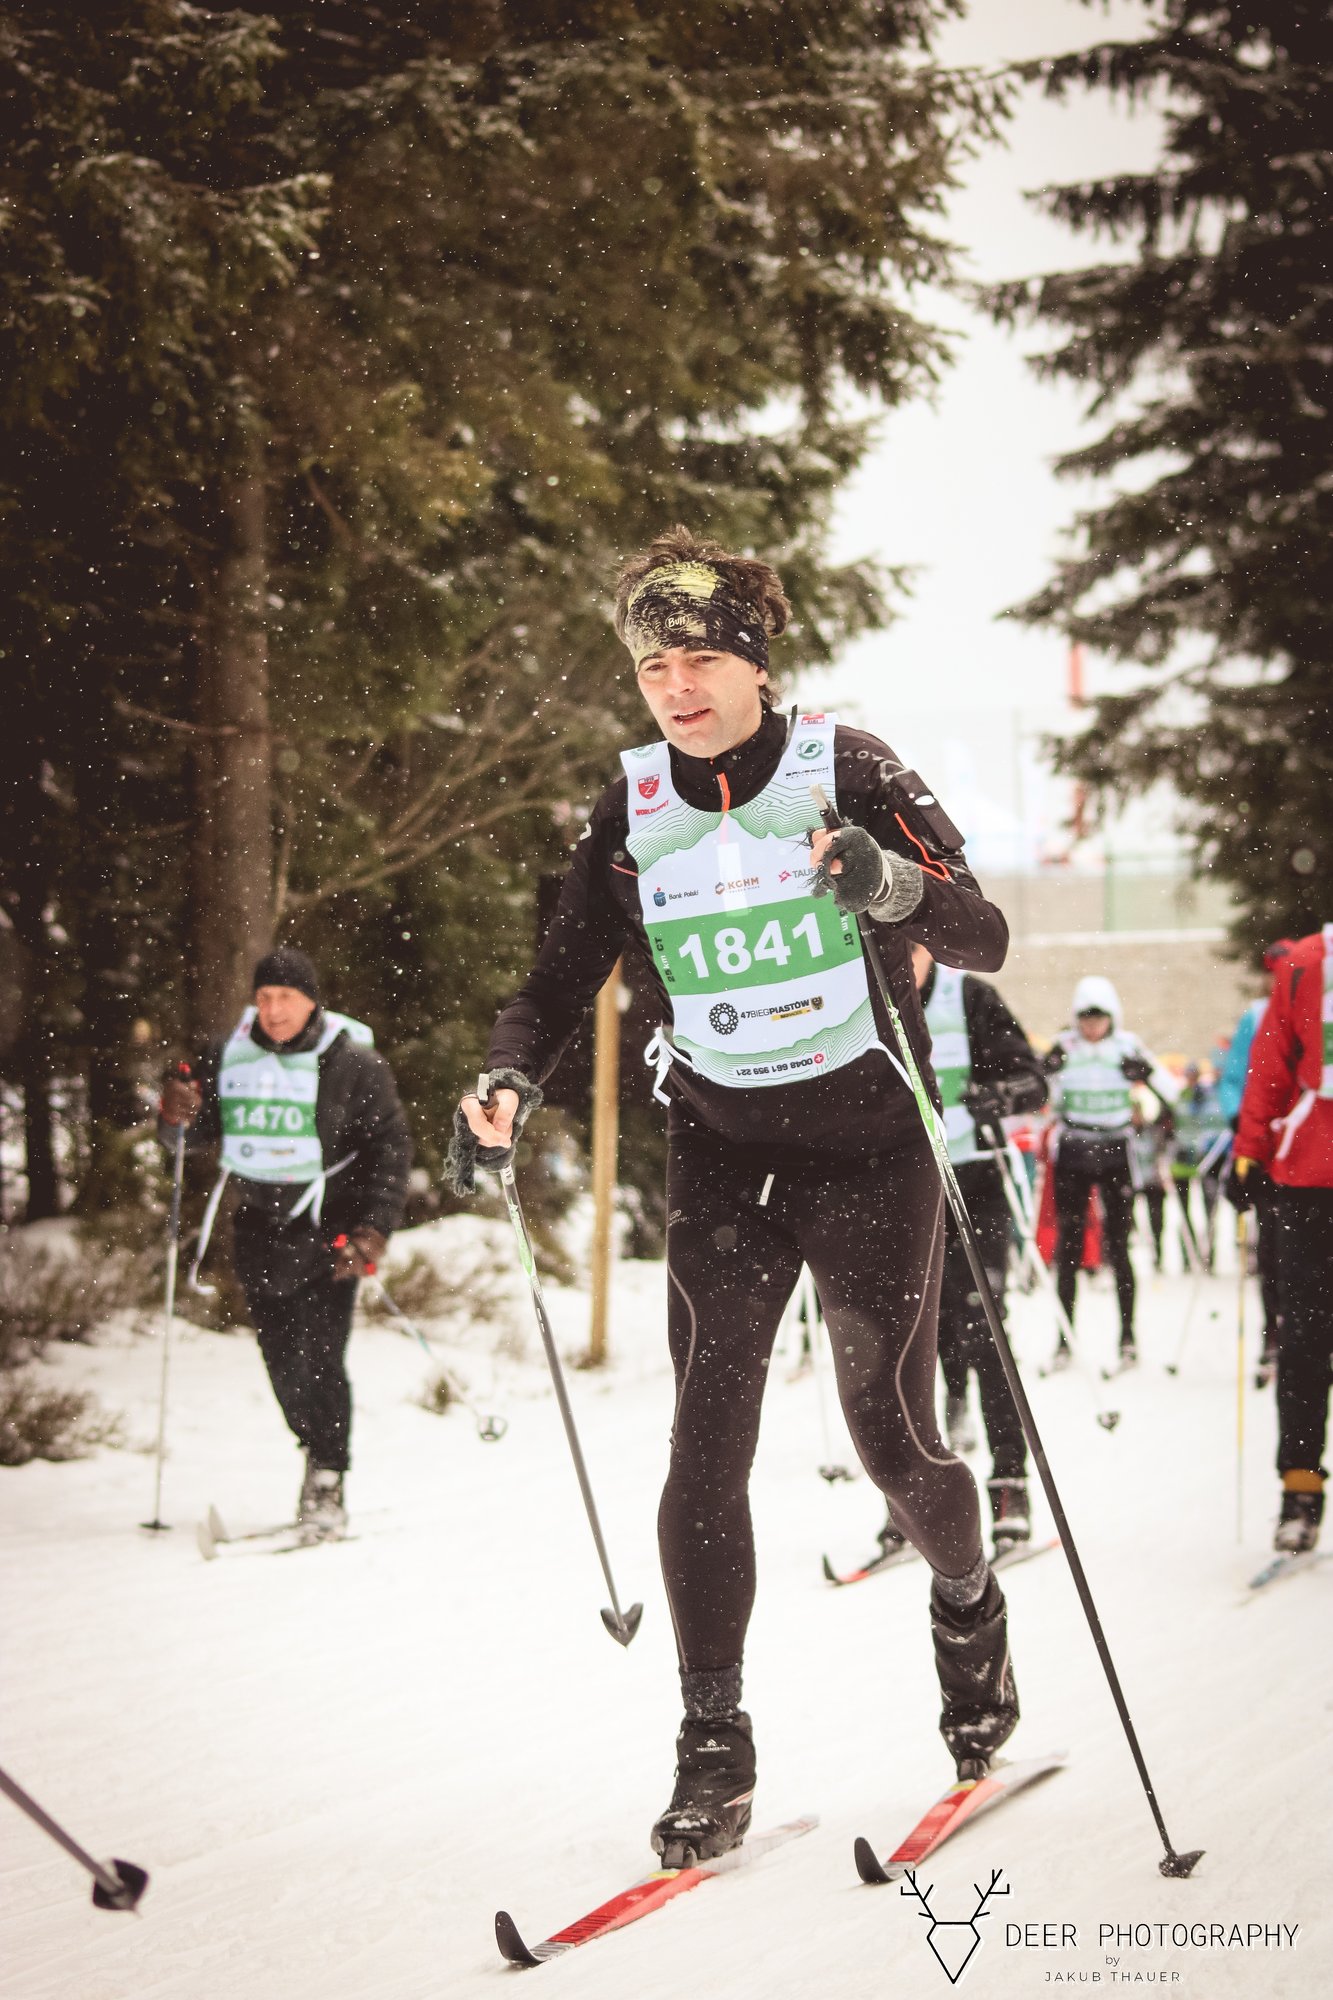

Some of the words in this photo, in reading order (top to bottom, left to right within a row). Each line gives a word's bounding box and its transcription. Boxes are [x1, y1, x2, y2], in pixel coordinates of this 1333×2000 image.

[792, 867, 818, 878] TAUR
[727, 877, 760, 890] KGHM
[684, 889, 699, 898] Polski
[654, 936, 665, 951] CT
[678, 912, 824, 979] 1841
[843, 933, 854, 946] CT
[790, 1058, 813, 1069] 0048
[736, 1068, 751, 1076] 221
[233, 1104, 304, 1132] 1470
